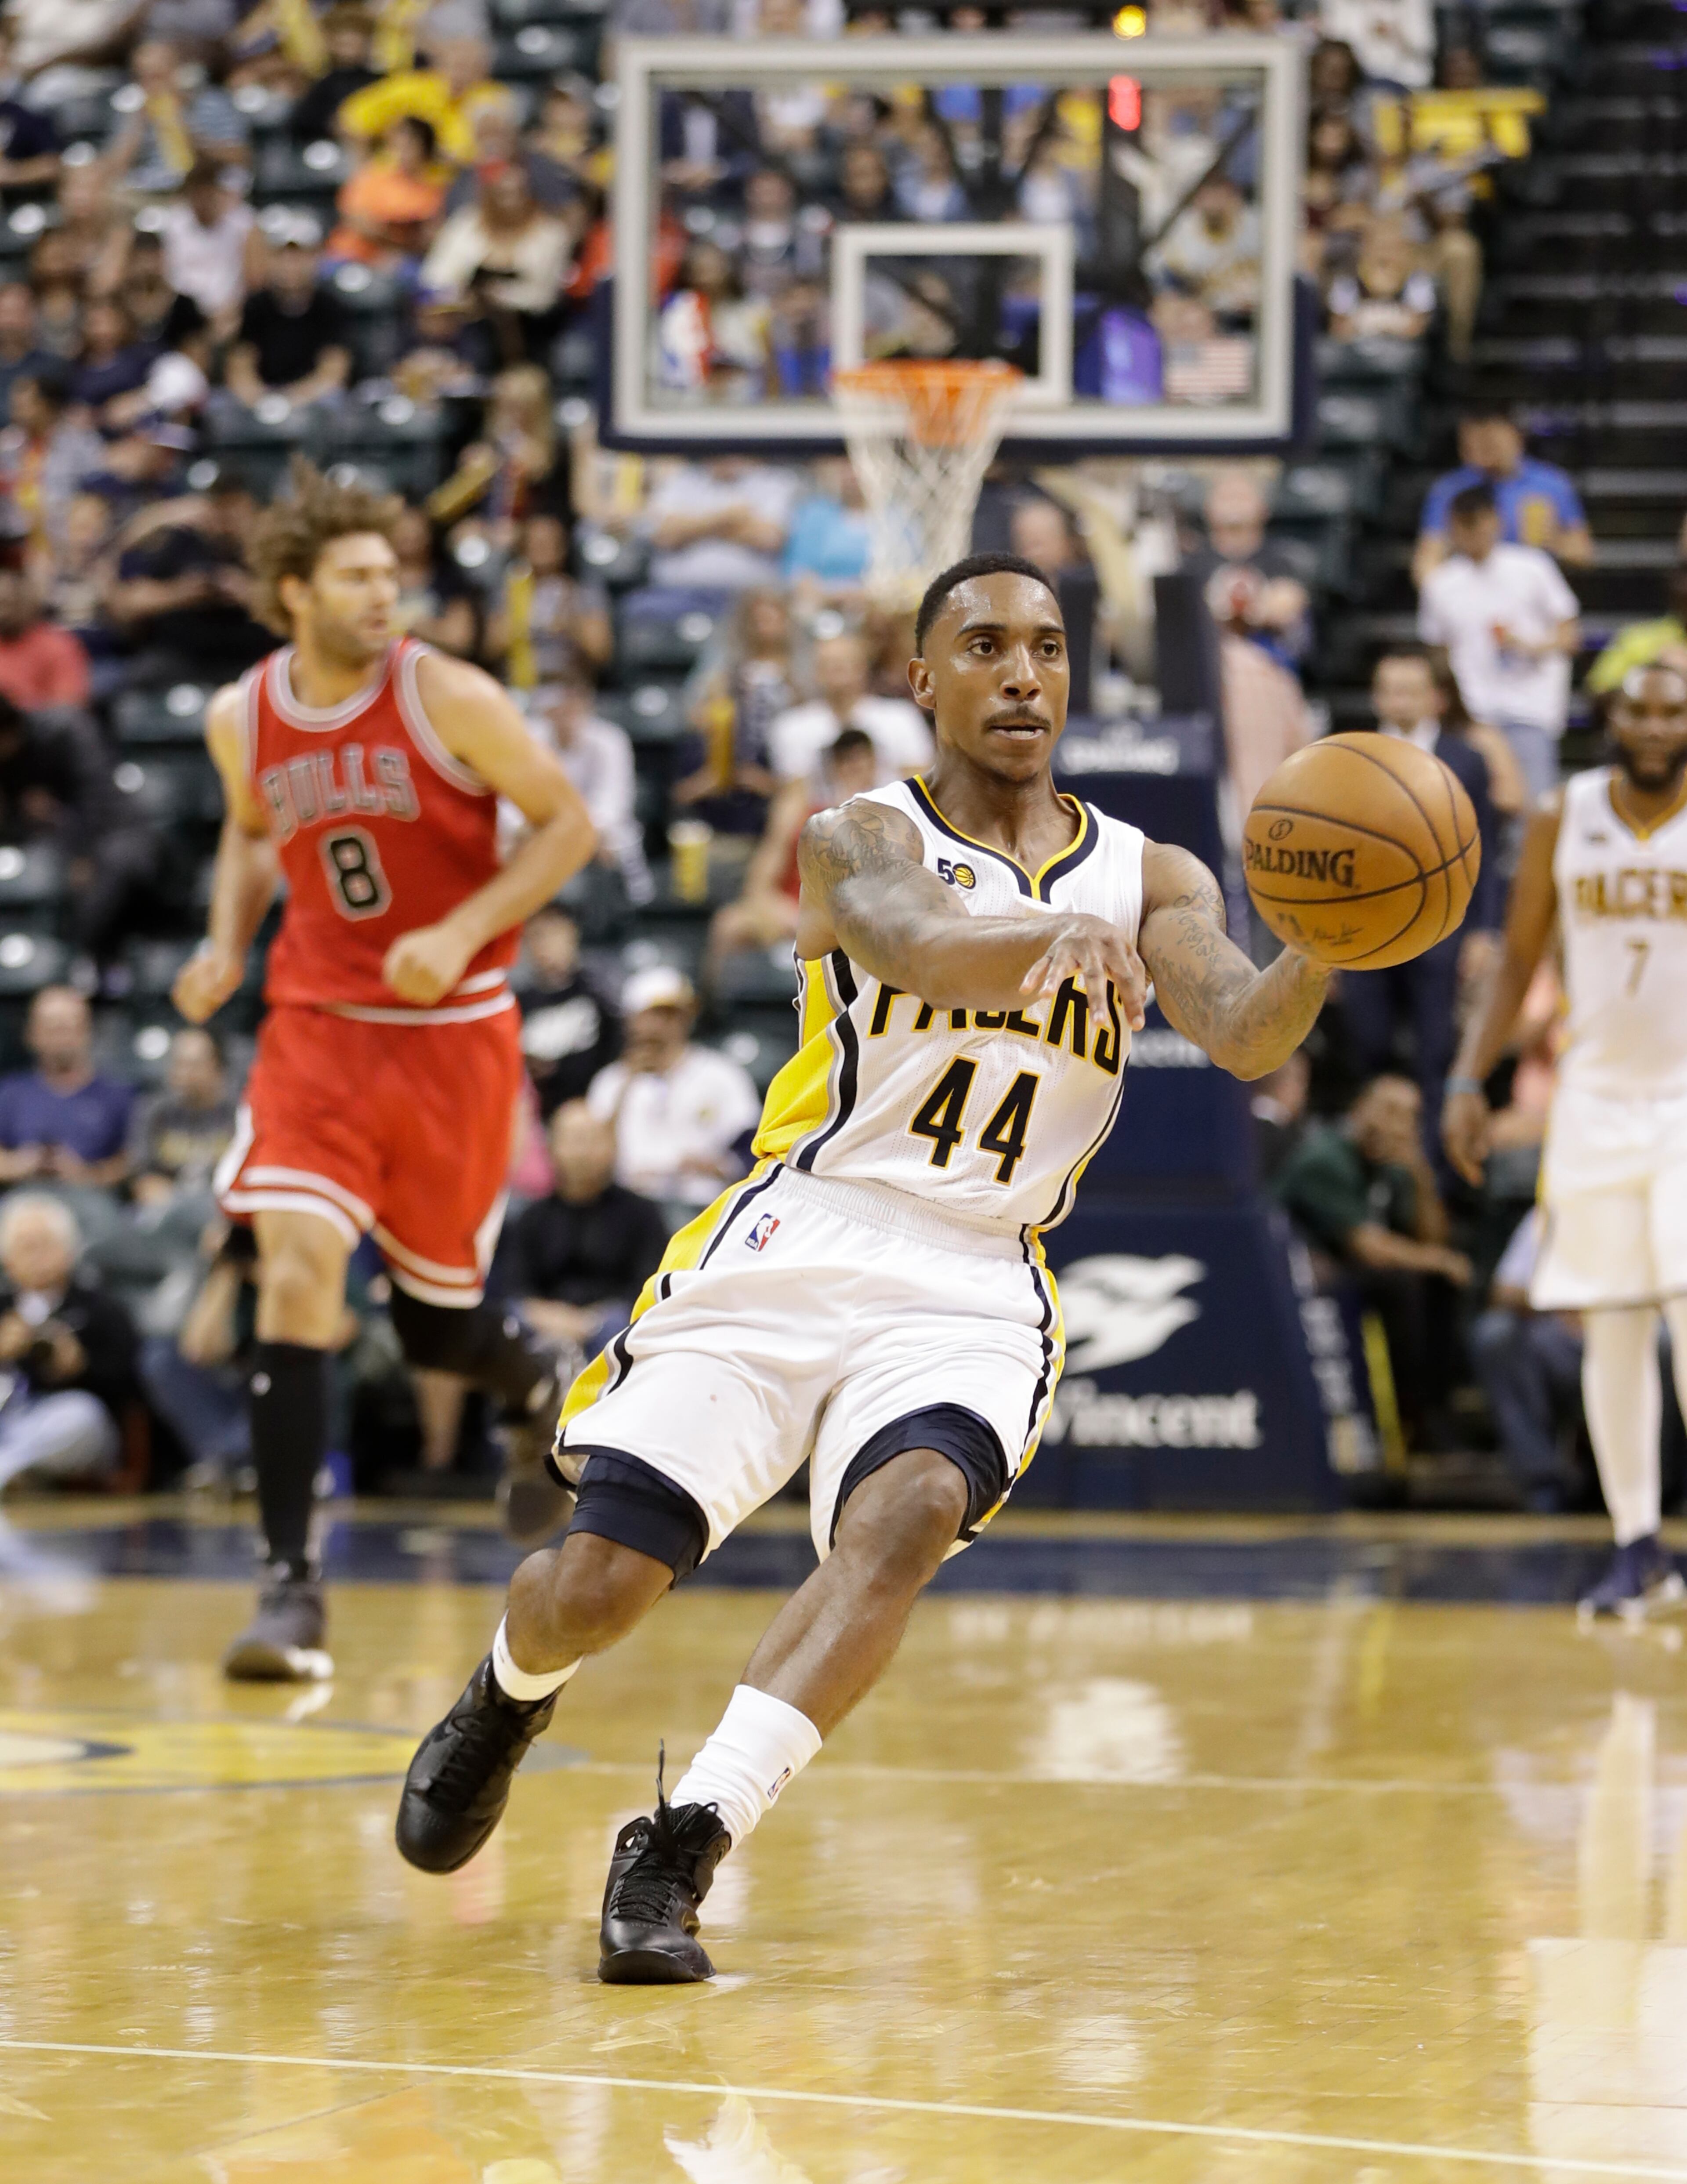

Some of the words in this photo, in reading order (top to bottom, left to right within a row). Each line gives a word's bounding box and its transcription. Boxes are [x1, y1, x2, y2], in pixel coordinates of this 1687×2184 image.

[260, 744, 419, 843] BULLS
[323, 829, 387, 916] 8
[1626, 938, 1649, 996] 7
[867, 972, 1123, 1077] PRS
[908, 1054, 1041, 1185] 44
